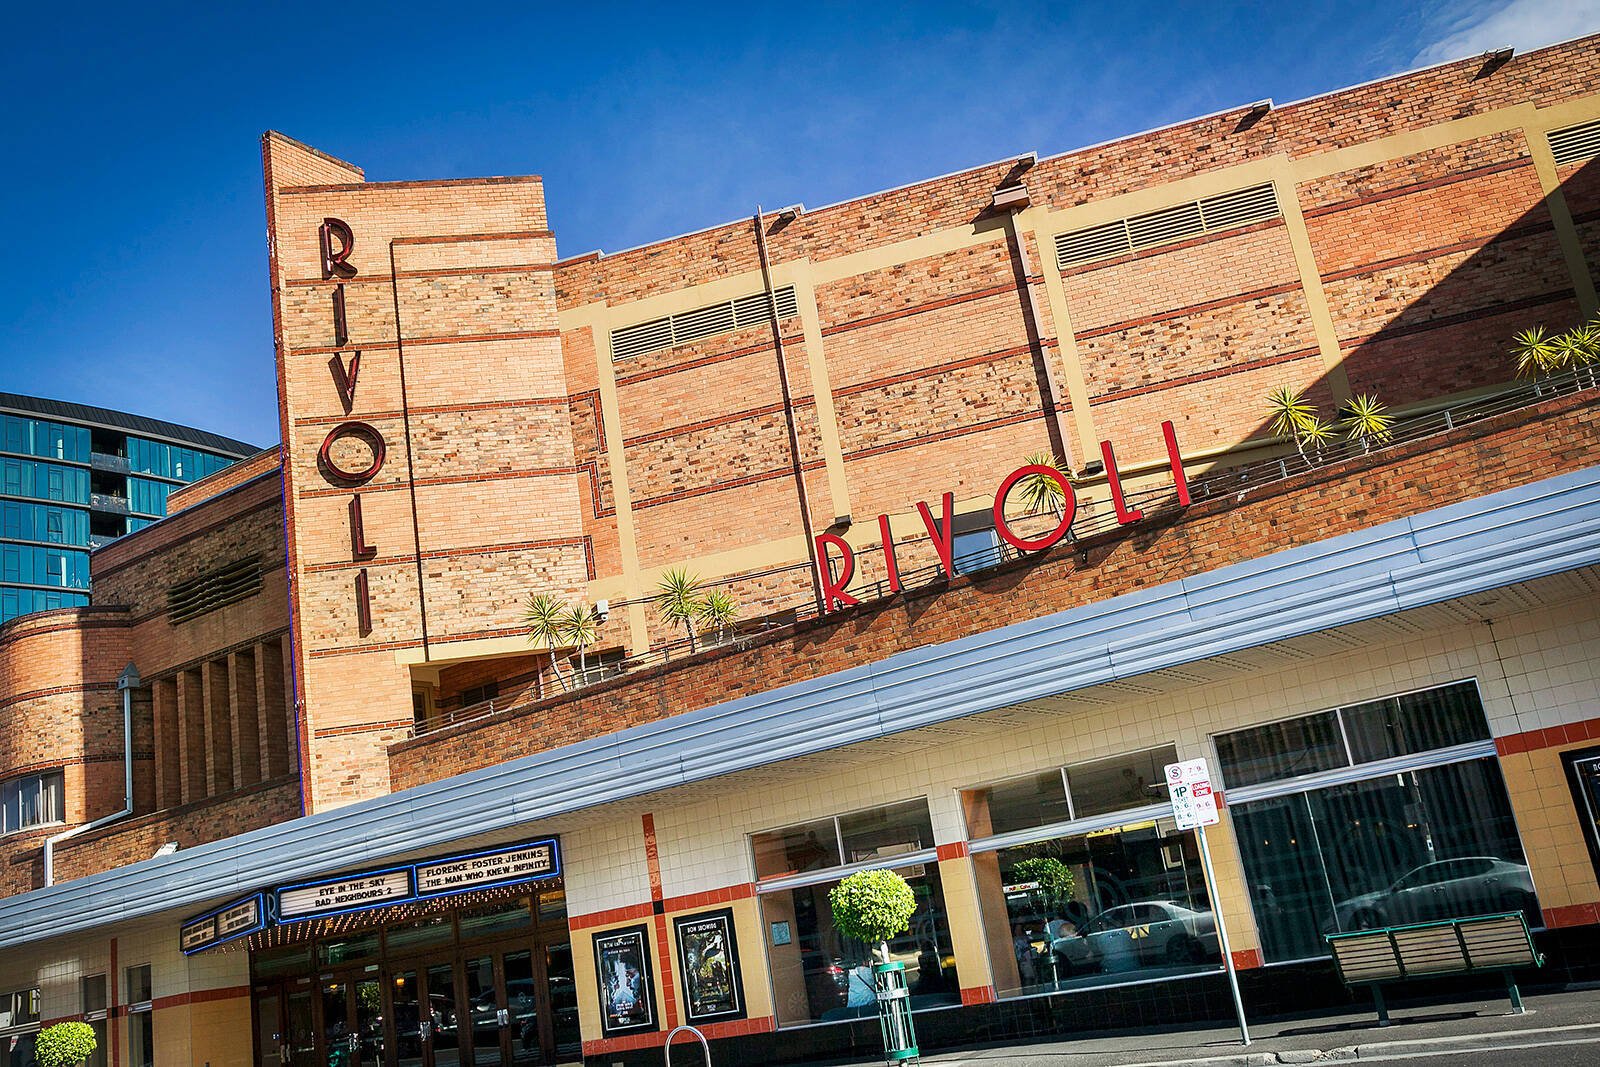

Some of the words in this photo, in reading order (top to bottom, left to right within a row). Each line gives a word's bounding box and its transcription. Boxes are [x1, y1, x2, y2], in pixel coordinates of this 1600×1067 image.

[319, 217, 387, 639] RIVOLI
[815, 420, 1192, 612] RIVOLI
[1173, 786, 1187, 797] 1P
[426, 863, 468, 877] FLORENCE
[472, 857, 503, 870] FOSTER
[505, 850, 543, 863] JENKINS
[426, 876, 444, 888] THE
[445, 872, 463, 884] MAN
[465, 870, 484, 881] WHO
[486, 865, 511, 877] KNEW
[513, 859, 548, 873] INFINITY
[315, 896, 331, 908] BAD
[335, 888, 383, 903] NEIGHBOURS
[386, 887, 393, 895] 2
[319, 885, 335, 897] EYE
[338, 883, 346, 893] IN
[349, 881, 365, 891] THE
[369, 878, 386, 888] SKY
